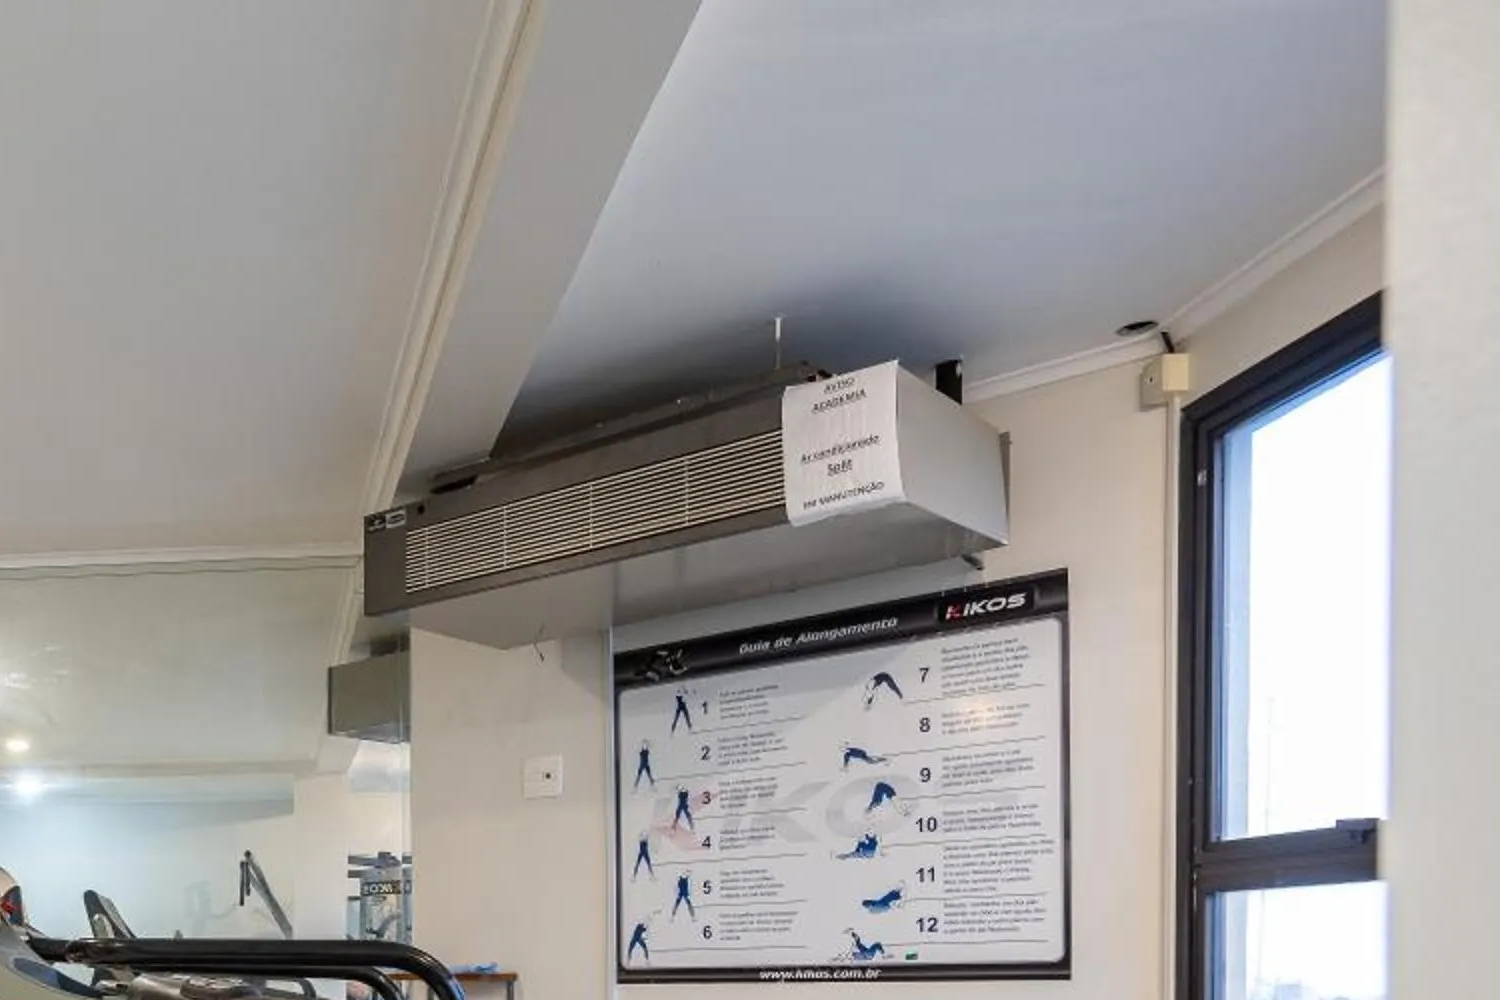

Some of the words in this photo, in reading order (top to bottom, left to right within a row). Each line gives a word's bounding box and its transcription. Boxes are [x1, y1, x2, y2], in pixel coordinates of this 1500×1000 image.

[945, 592, 1028, 620] KIKOS
[773, 634, 793, 649] de
[919, 667, 929, 682] 7
[702, 700, 708, 715] 1
[919, 717, 931, 733] 8
[701, 745, 711, 760] 2
[920, 767, 931, 783] 9
[702, 791, 711, 805] 3
[916, 816, 937, 832] 10
[701, 835, 711, 849] 4
[916, 867, 936, 883] 11
[703, 880, 712, 895] 5
[703, 925, 712, 940] 6
[916, 917, 938, 933] 12
